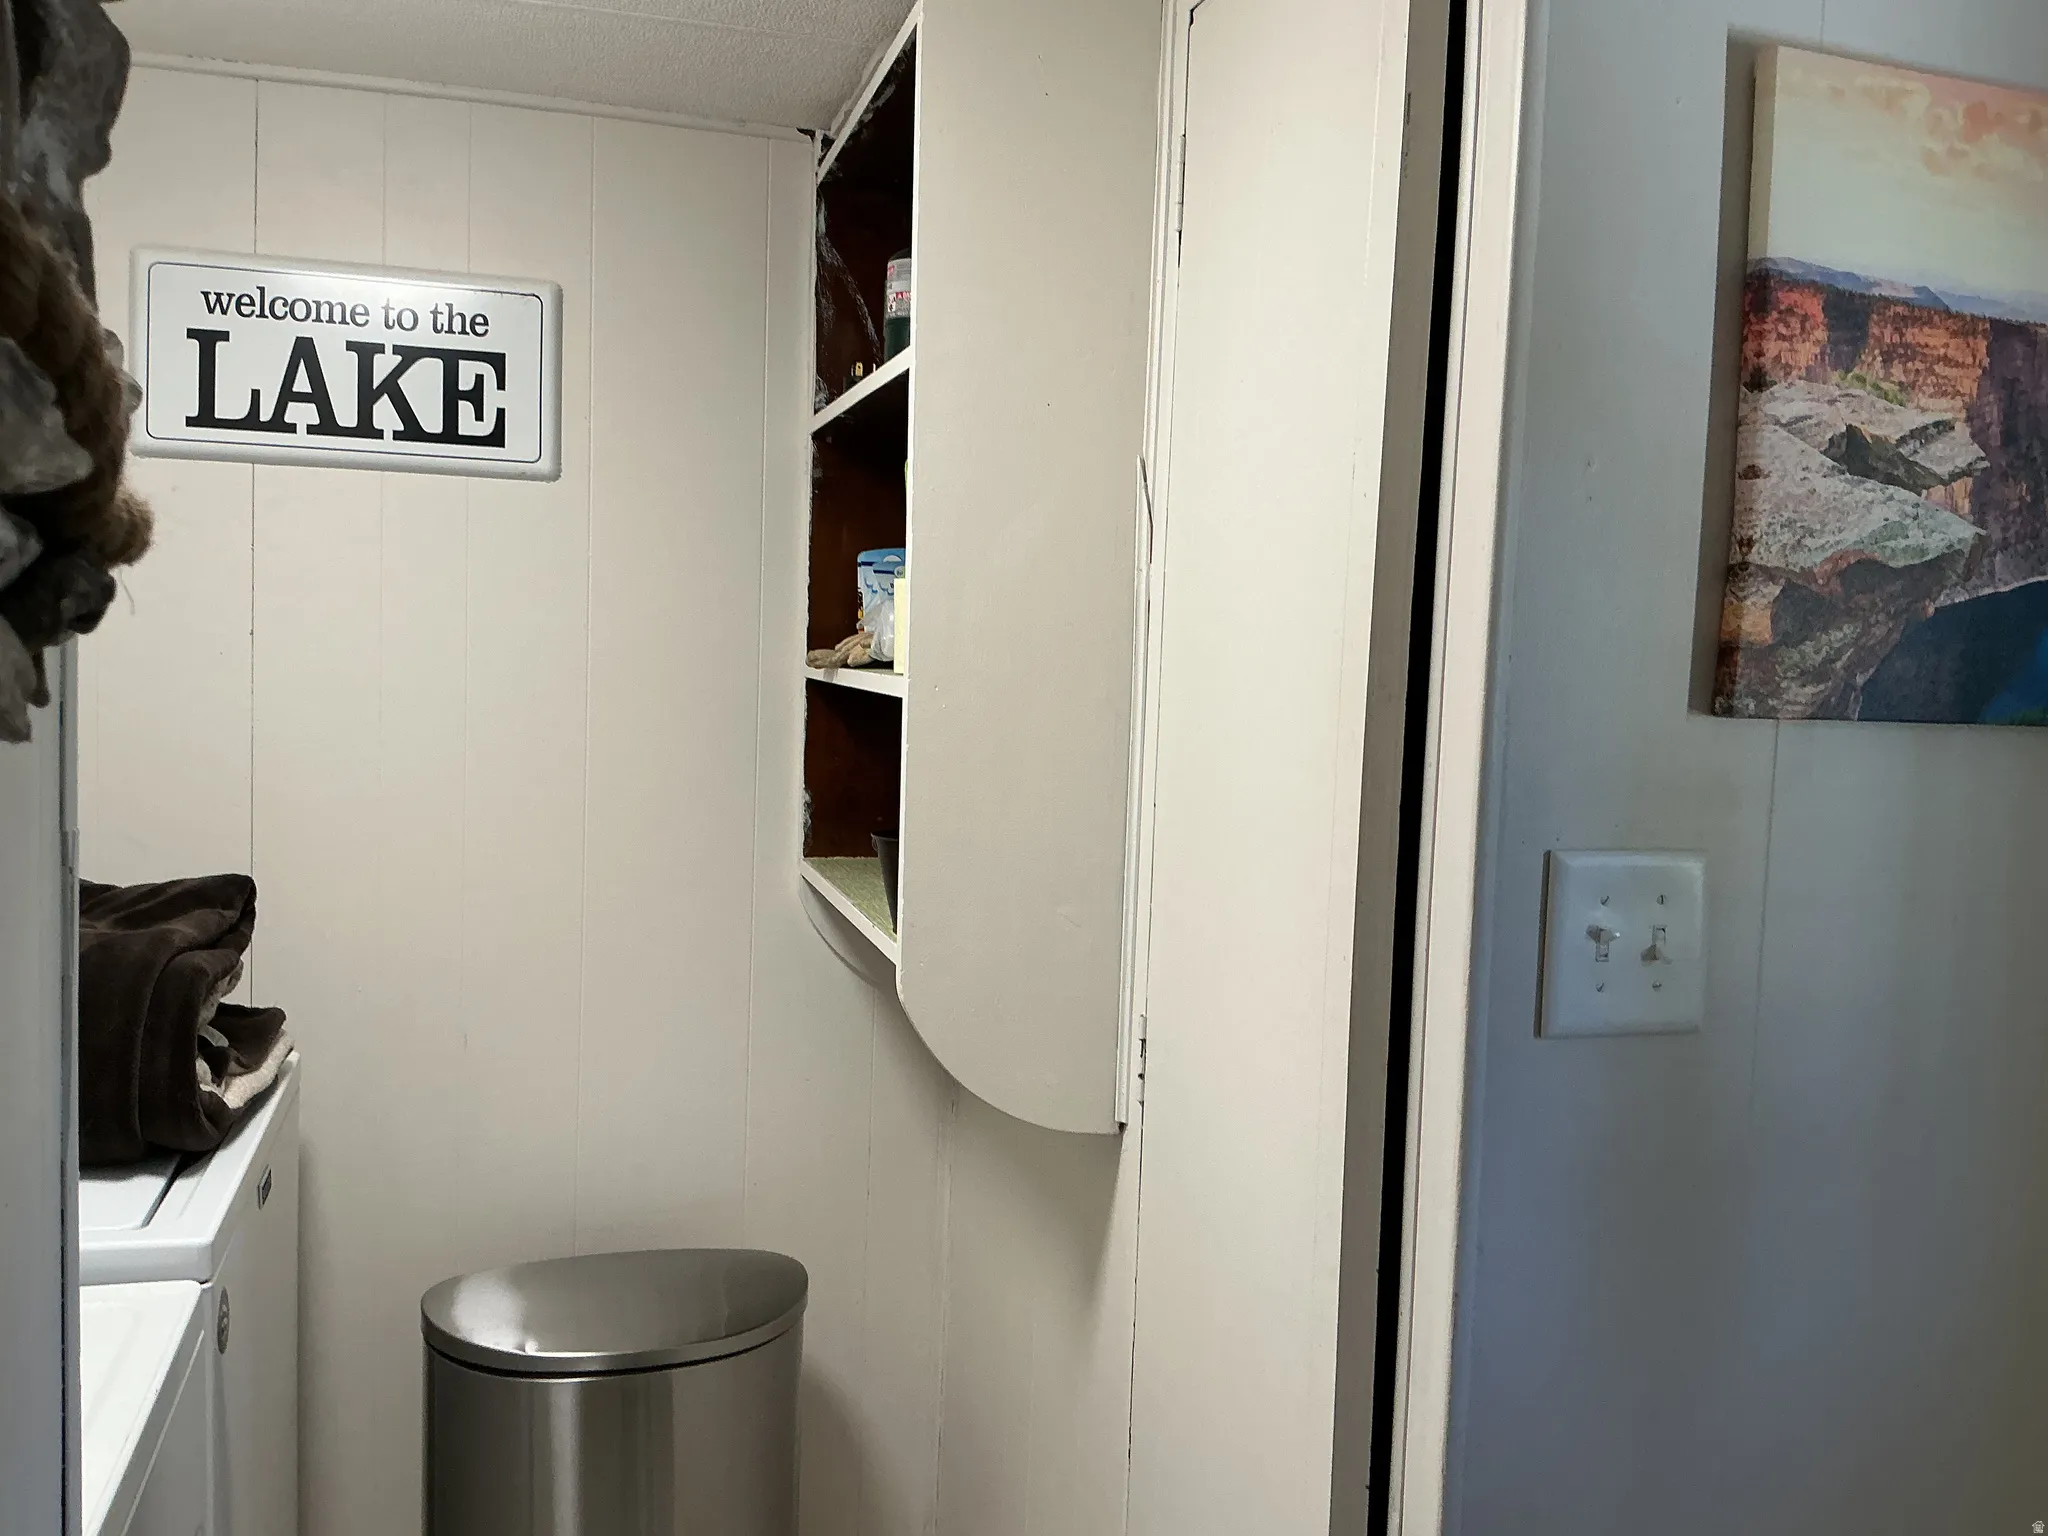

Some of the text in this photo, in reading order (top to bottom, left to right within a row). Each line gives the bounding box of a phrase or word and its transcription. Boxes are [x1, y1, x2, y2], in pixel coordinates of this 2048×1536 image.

[201, 286, 490, 338] welcome to the
[185, 328, 506, 448] LAKE
